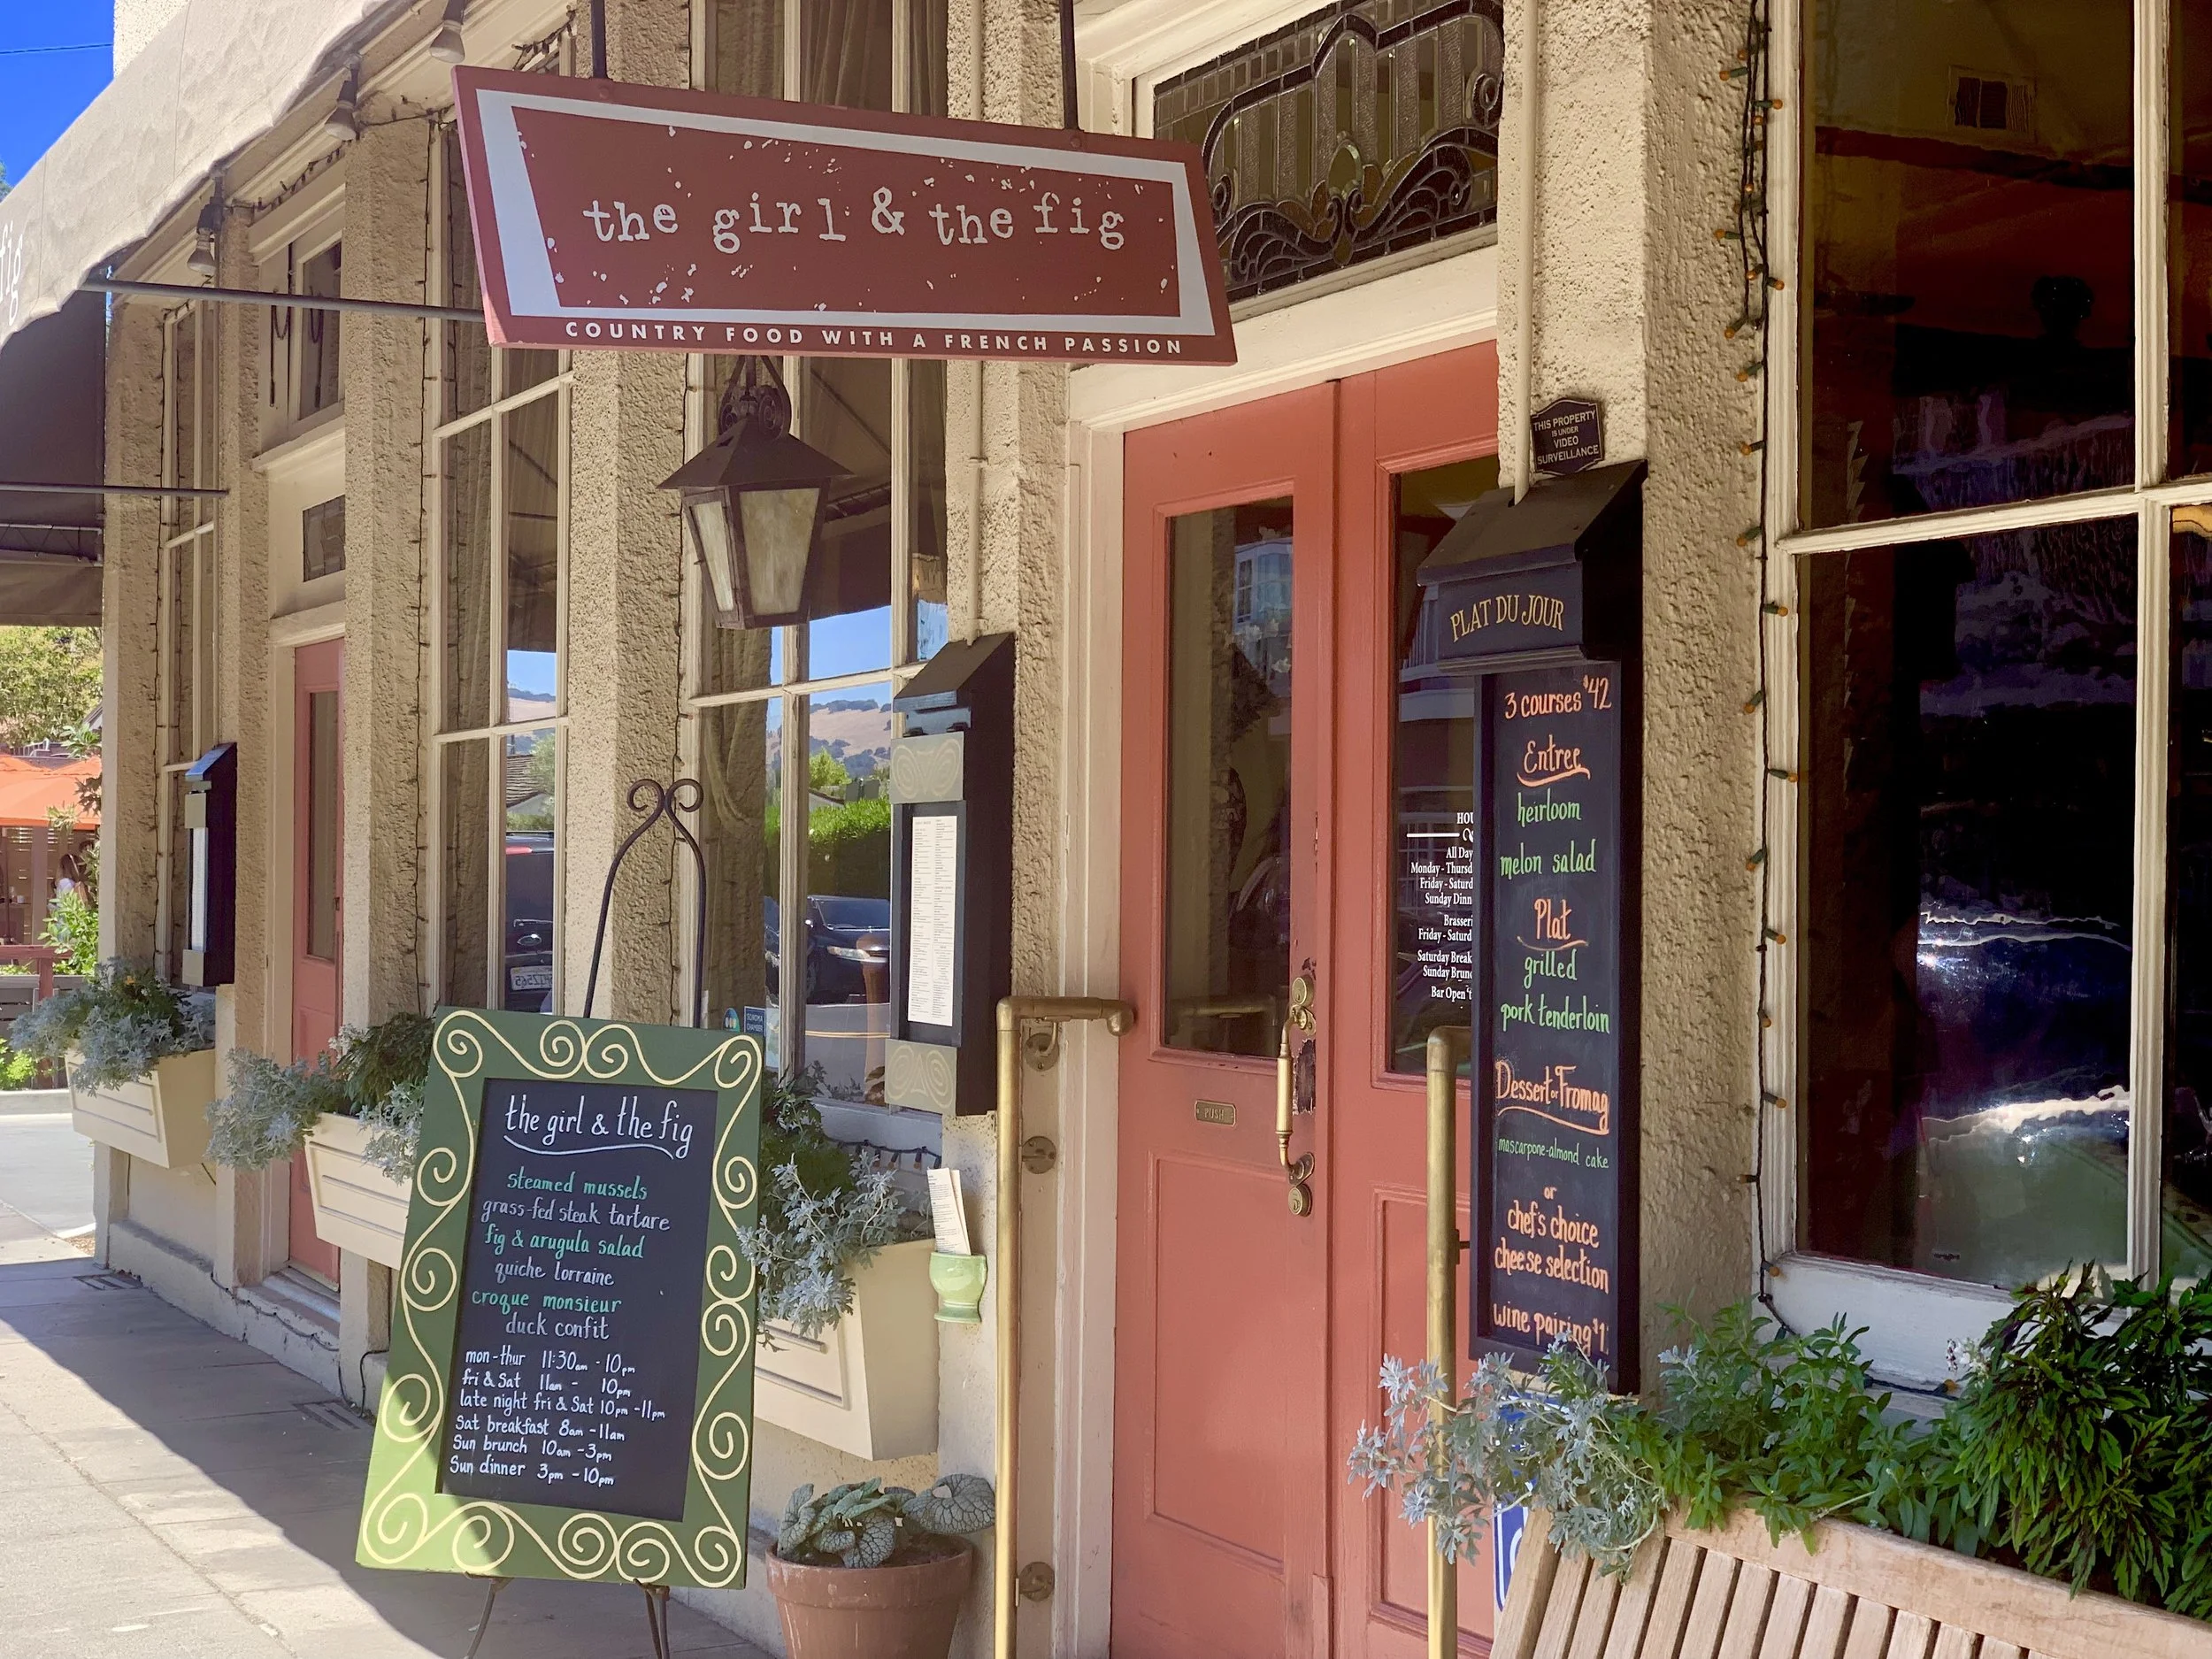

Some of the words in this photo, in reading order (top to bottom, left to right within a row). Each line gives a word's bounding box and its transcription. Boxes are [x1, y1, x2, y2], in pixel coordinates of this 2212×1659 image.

[583, 200, 679, 242] the
[713, 192, 847, 254] girl
[871, 186, 905, 235] &
[928, 204, 1014, 245] the
[1033, 191, 1125, 250] fig
[565, 321, 705, 342] COUNTRY
[726, 326, 803, 344] FOOD
[821, 330, 893, 346] WITH
[912, 334, 926, 348] A
[945, 334, 1047, 351] FRENCH
[1064, 337, 1181, 354] PASSION
[1533, 419, 1552, 432] THIS
[1553, 410, 1596, 428] PROPERTY
[1558, 426, 1578, 436] UNDER
[1537, 444, 1600, 465] SURVEILLANCE
[1553, 435, 1579, 449] VIDEO
[1449, 598, 1492, 643] PLAT
[1495, 594, 1520, 625] DU
[1521, 594, 1564, 632] JOUR
[1504, 692, 1517, 719] 3
[1520, 690, 1583, 718] courses
[1524, 734, 1582, 774] Entree
[1517, 787, 1582, 827] heirloom
[1410, 862, 1440, 877] Monday
[1446, 862, 1473, 875] Thursd
[1446, 847, 1457, 860] All
[1458, 847, 1473, 863] Day
[1500, 841, 1543, 879] melon
[1552, 838, 1597, 874] salad
[1420, 877, 1444, 892] Friday
[1448, 877, 1473, 890] Saturd
[1425, 892, 1452, 907] Sunday
[1453, 892, 1472, 905] Dinn
[1533, 897, 1572, 940] Plat
[1418, 928, 1442, 943] Friday
[1447, 929, 1472, 942] Saturd
[1417, 949, 1449, 966] Saturday
[1450, 951, 1472, 964] Break
[1523, 949, 1578, 989] grilled
[1423, 965, 1450, 981] Sunday
[1431, 986, 1445, 999] Bar
[1446, 987, 1466, 1002] Open
[1501, 994, 1535, 1033] pork
[1537, 993, 1610, 1034] tenderloin
[1494, 1060, 1554, 1105] Dessert
[504, 1094, 539, 1134] the
[541, 1094, 585, 1146] girl
[590, 1113, 610, 1136] &
[617, 1095, 654, 1140] the
[658, 1099, 694, 1159] fig
[1204, 1107, 1225, 1120] PUSH
[1498, 1137, 1580, 1166] mascarpone-almond
[1586, 1148, 1609, 1169] cake
[507, 1165, 576, 1194] steamed
[583, 1174, 648, 1201] mussels
[1543, 1186, 1557, 1200] or
[480, 1196, 554, 1224] grass-fed
[558, 1202, 602, 1225] steak
[608, 1202, 671, 1232] tartare
[1507, 1199, 1547, 1239] chef's
[1549, 1205, 1600, 1248] choice
[484, 1222, 505, 1255] fig
[511, 1229, 525, 1248] &
[529, 1229, 590, 1260] arugula
[597, 1234, 646, 1259] salad
[495, 1256, 546, 1284] quiche
[554, 1261, 615, 1286] lorraine
[1494, 1237, 1542, 1276] cheese
[1545, 1244, 1609, 1294] selection
[472, 1289, 530, 1315] croque
[542, 1294, 623, 1314] monsieur
[505, 1311, 549, 1337] duck
[555, 1316, 611, 1341] confit
[1493, 1301, 1531, 1333] wine
[1533, 1312, 1592, 1357] pairing
[465, 1344, 526, 1367] mon-thur
[541, 1350, 588, 1371] 11:30am
[605, 1353, 635, 1376] 10pm
[462, 1369, 479, 1386] fri
[483, 1370, 495, 1388] &
[497, 1371, 522, 1389] Sat
[539, 1373, 563, 1392] 11am
[602, 1378, 631, 1399] 10pm
[460, 1389, 488, 1409] late
[493, 1392, 528, 1417] night
[534, 1394, 552, 1412] fri
[556, 1394, 568, 1412] &
[571, 1395, 595, 1415] Sat
[600, 1400, 629, 1417] 10pm
[455, 1414, 480, 1431] Sat
[487, 1415, 549, 1436] breakfast
[558, 1418, 584, 1437] 8am
[452, 1434, 476, 1451] Sun
[483, 1434, 528, 1454] brunch
[541, 1440, 572, 1458] 10am
[449, 1455, 474, 1475] Sun
[479, 1455, 526, 1477] dinner
[536, 1463, 564, 1484] 3pm
